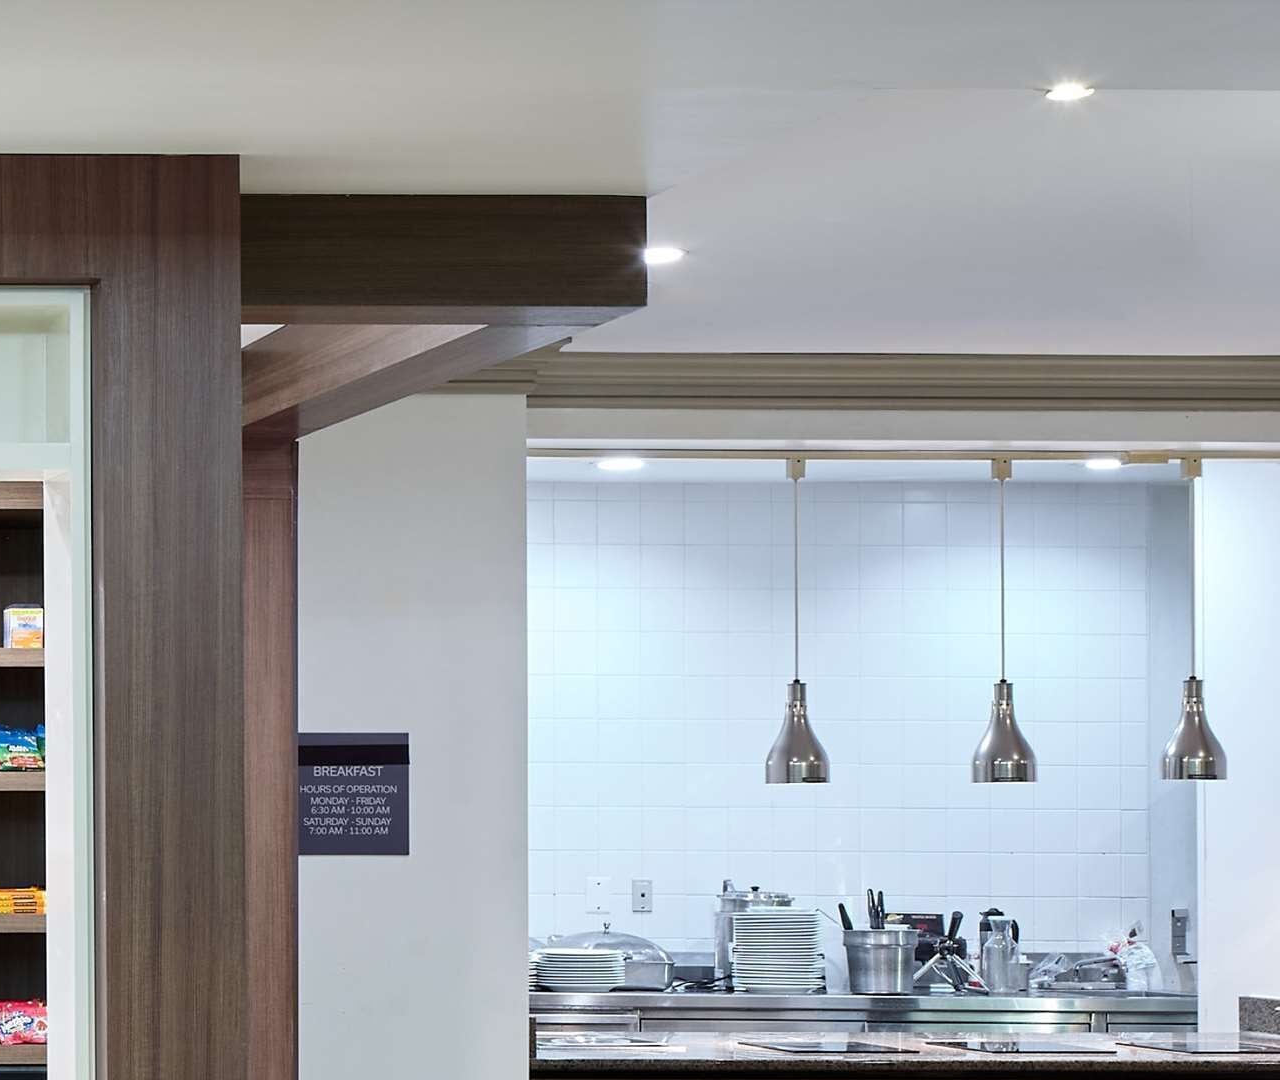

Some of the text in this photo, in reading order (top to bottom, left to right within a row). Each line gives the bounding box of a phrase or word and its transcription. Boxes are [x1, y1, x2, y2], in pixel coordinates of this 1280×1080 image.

[313, 766, 384, 777] BREAKFAST
[299, 785, 397, 793] HOURS OF OPERATION
[310, 797, 349, 805] MONDAY
[356, 797, 387, 805] FRIDAY
[311, 806, 330, 814] 6:30
[330, 806, 345, 814] AM
[351, 806, 374, 814] 10:00
[375, 806, 390, 814] AM
[303, 818, 349, 826] SATURDAY
[355, 818, 392, 826] SUNDAY
[309, 827, 327, 835] 7:00
[328, 827, 343, 835] AM
[350, 827, 372, 835] 11:00
[373, 827, 389, 835] AM
